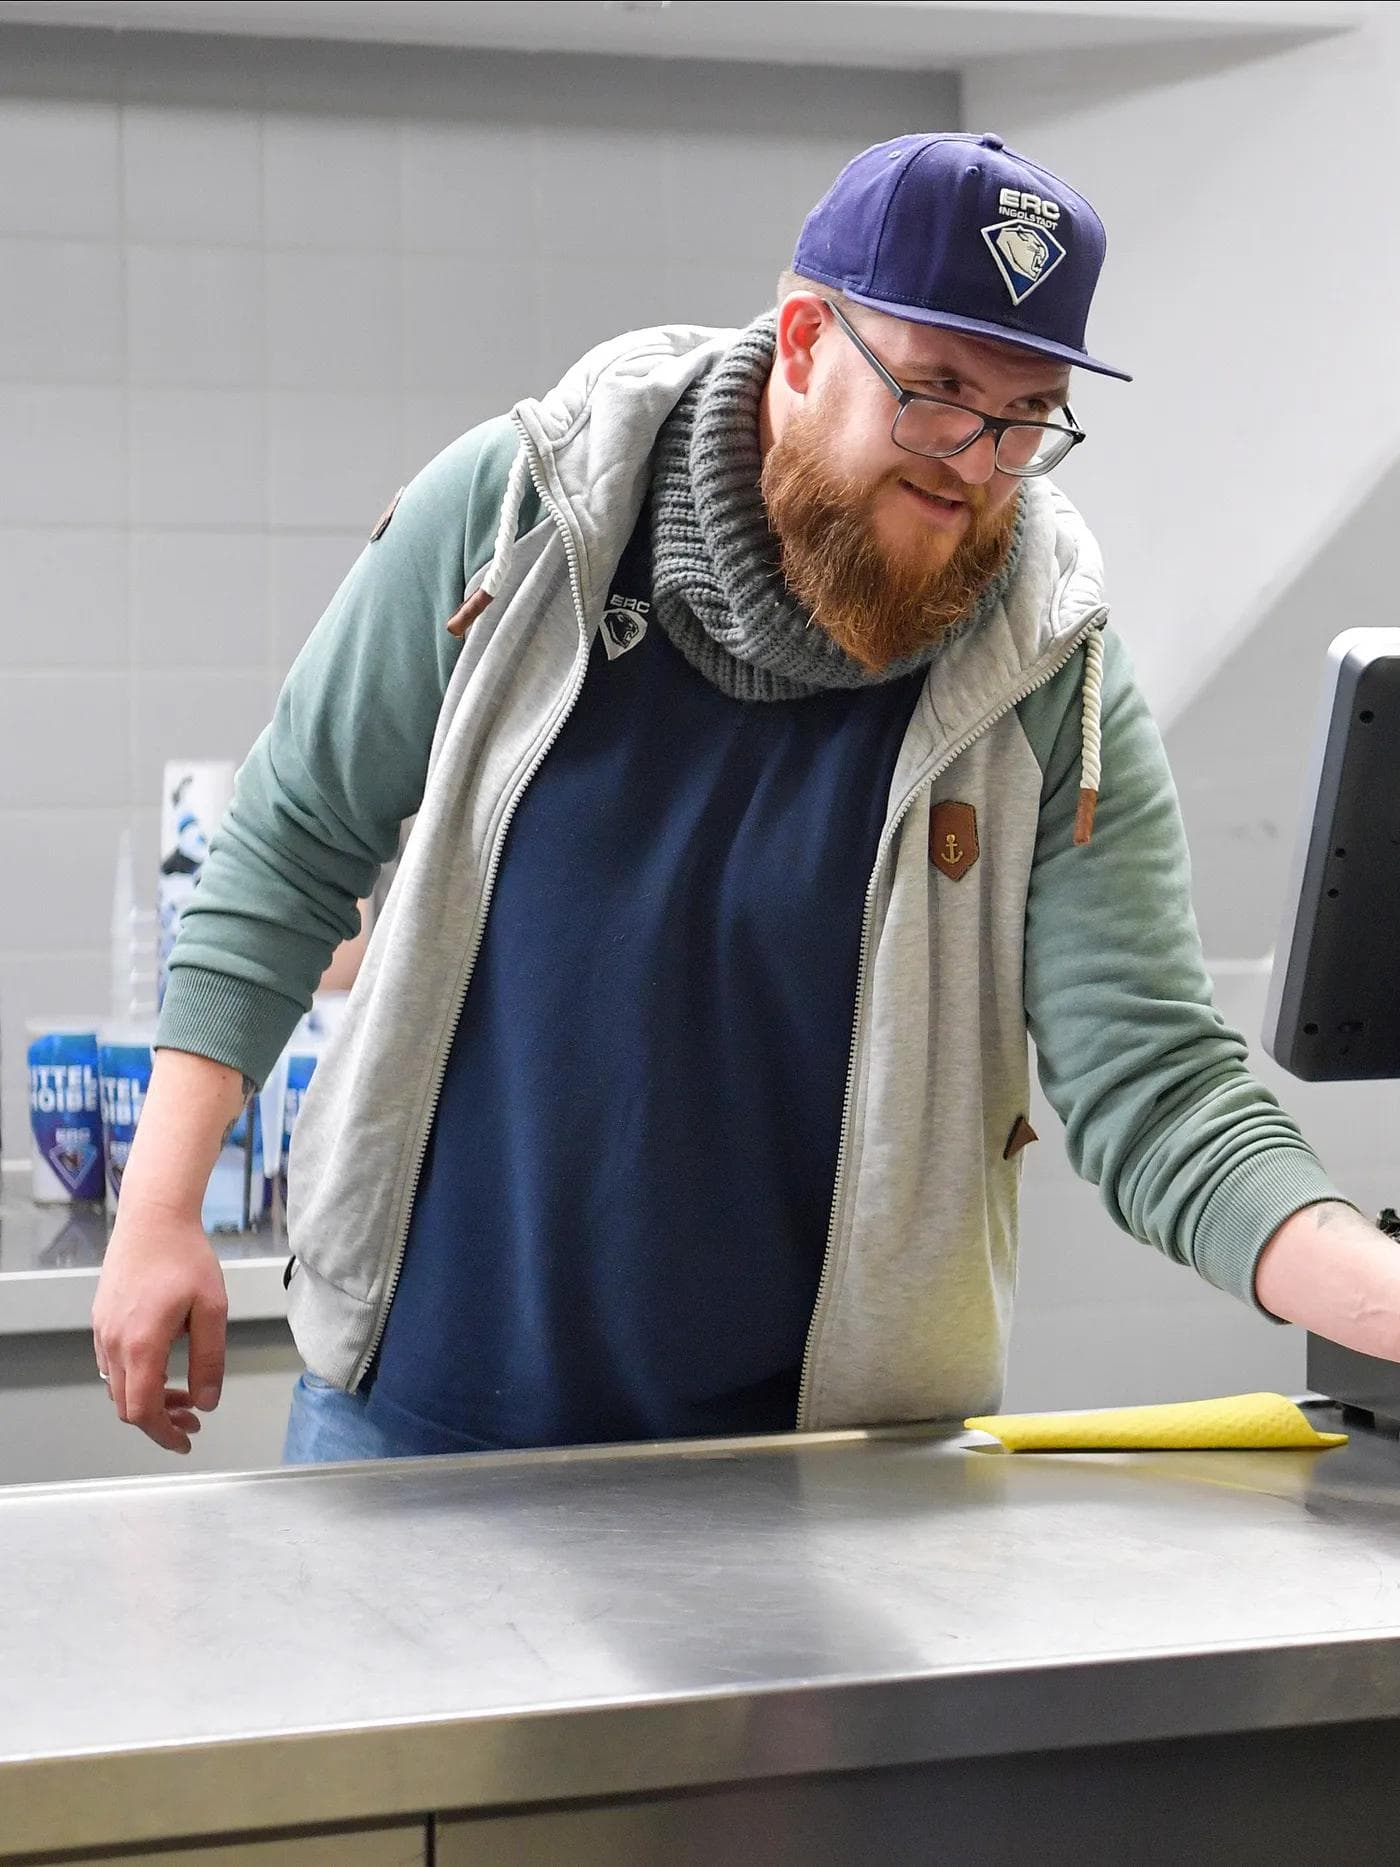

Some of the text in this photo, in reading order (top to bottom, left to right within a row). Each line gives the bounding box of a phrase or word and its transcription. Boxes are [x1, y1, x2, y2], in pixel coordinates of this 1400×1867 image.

[999, 188, 1061, 220] ERC
[999, 206, 1058, 230] INGOLSTADT
[610, 594, 650, 613] ERC
